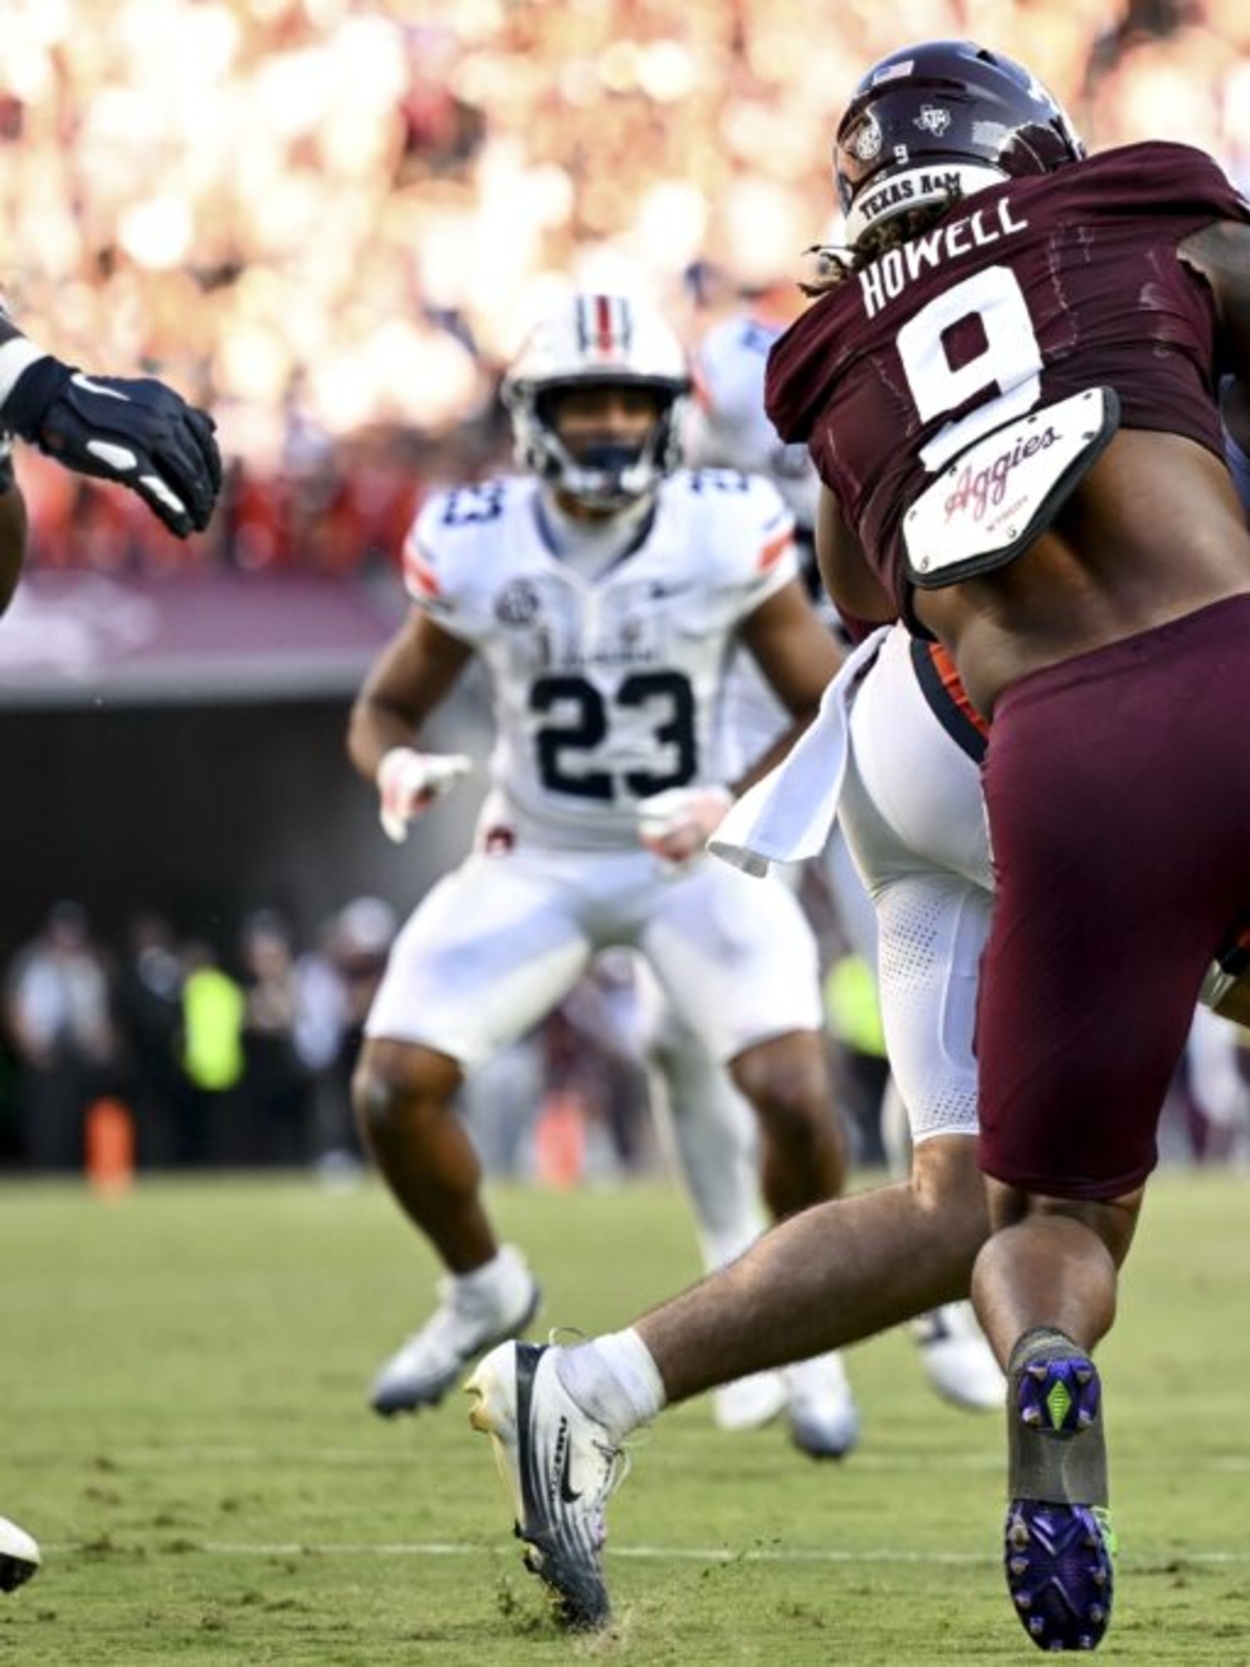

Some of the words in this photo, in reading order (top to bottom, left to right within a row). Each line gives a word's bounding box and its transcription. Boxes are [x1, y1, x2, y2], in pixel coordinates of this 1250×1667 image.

[859, 180, 913, 220] TEXAS
[920, 172, 962, 196] A&M
[893, 143, 909, 164] 9
[858, 197, 1028, 319] HOWELL
[896, 264, 1045, 472] 9
[944, 427, 1062, 524] Aggies
[528, 669, 699, 804] 23
